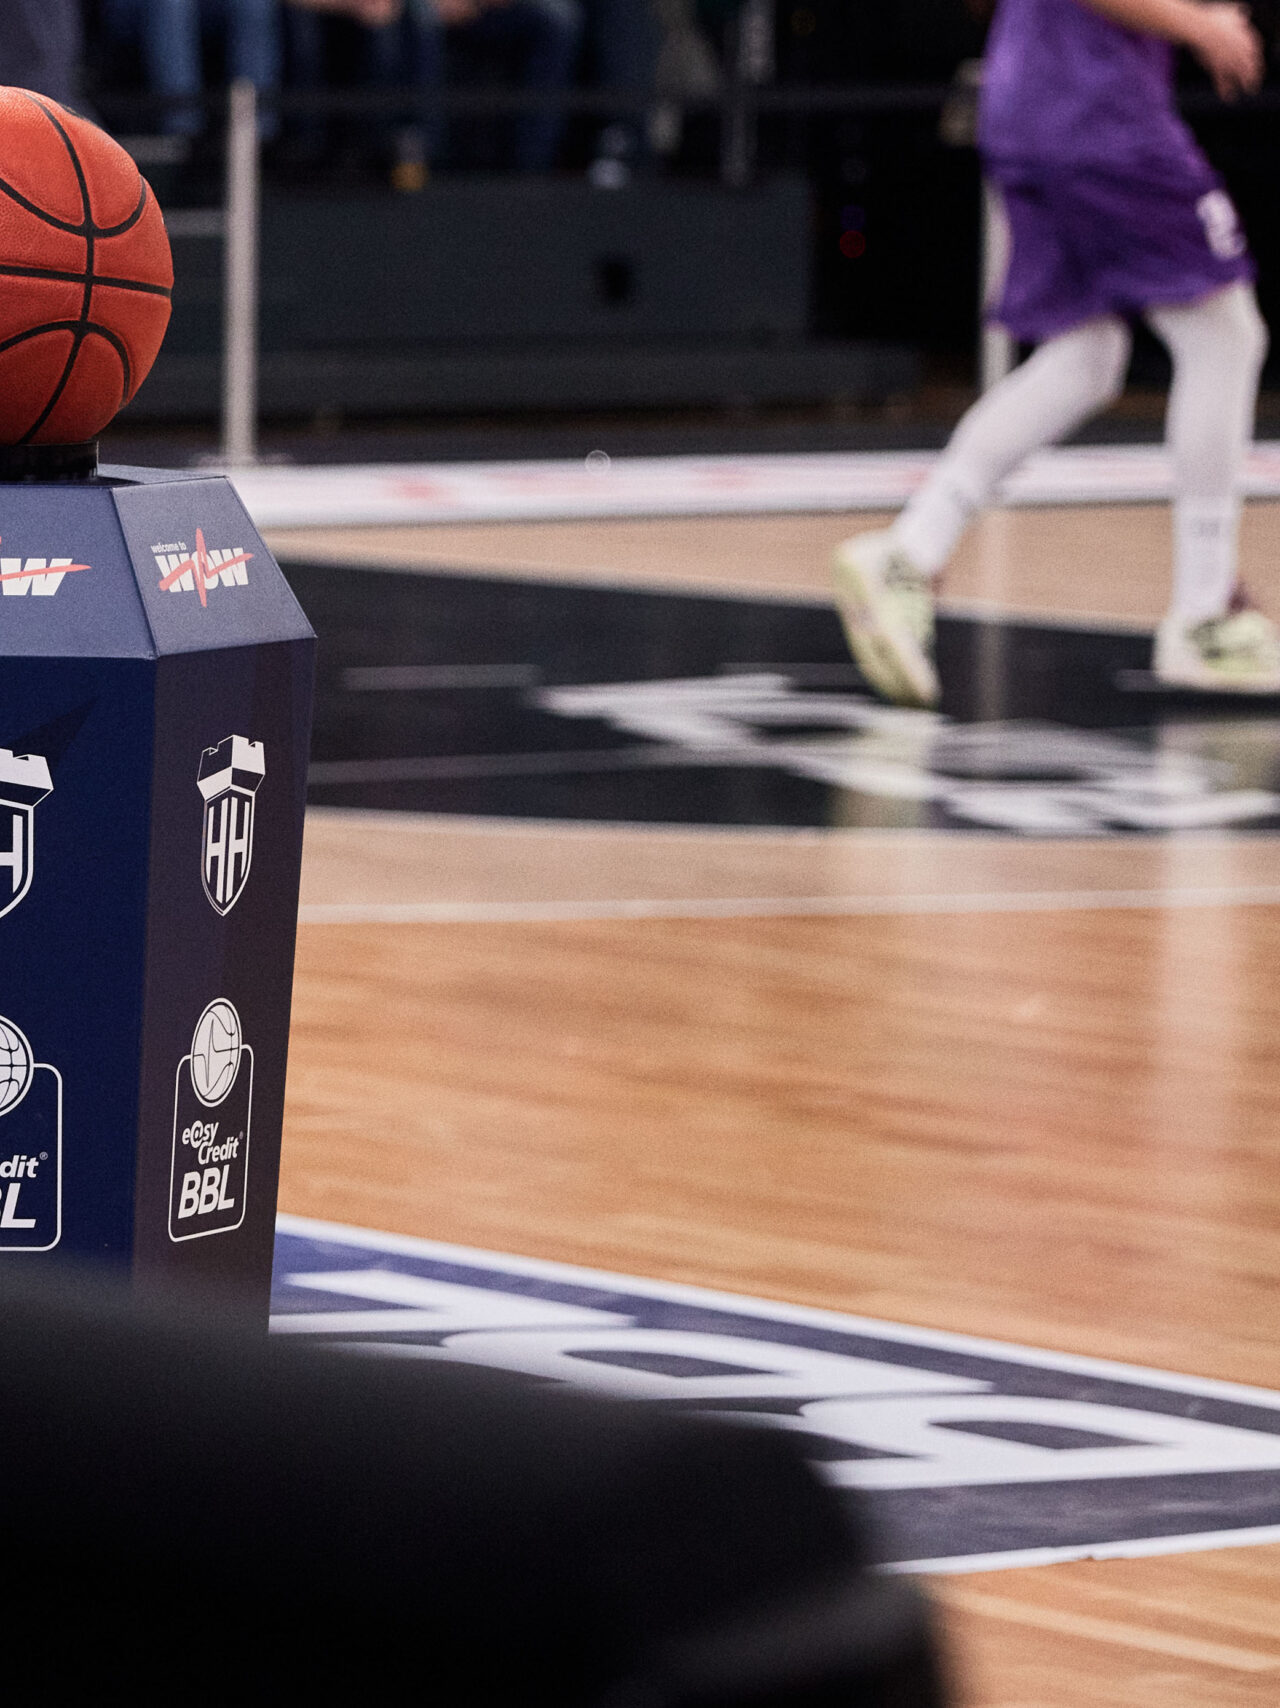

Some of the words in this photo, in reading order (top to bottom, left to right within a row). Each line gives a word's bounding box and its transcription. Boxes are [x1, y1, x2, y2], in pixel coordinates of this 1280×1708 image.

[151, 542, 179, 554] welcome
[178, 541, 187, 552] to
[154, 547, 249, 593] WOW
[206, 796, 250, 904] HH
[178, 1164, 235, 1219] BBL
